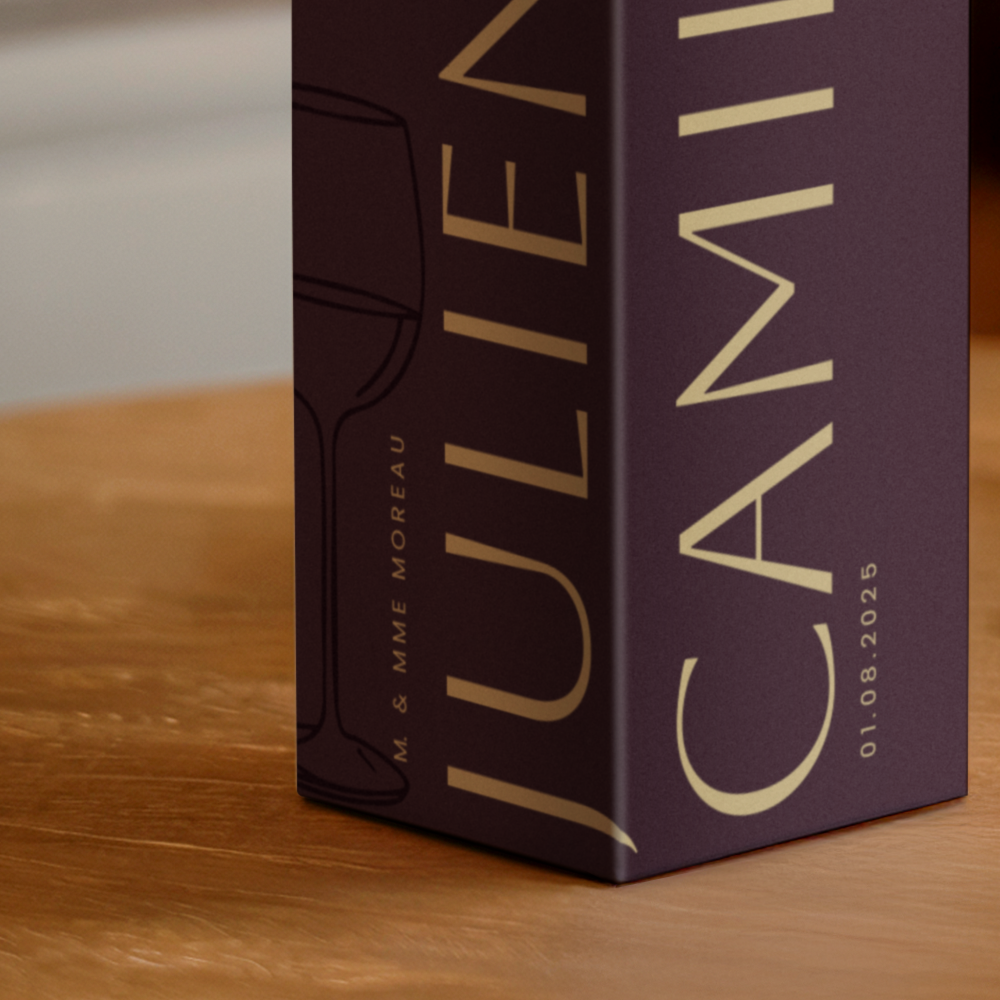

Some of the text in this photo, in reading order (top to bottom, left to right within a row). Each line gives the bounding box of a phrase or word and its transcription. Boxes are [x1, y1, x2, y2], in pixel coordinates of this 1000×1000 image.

[390, 434, 408, 763] M. & MME MOREAU
[859, 562, 878, 759] 01.08.2025
